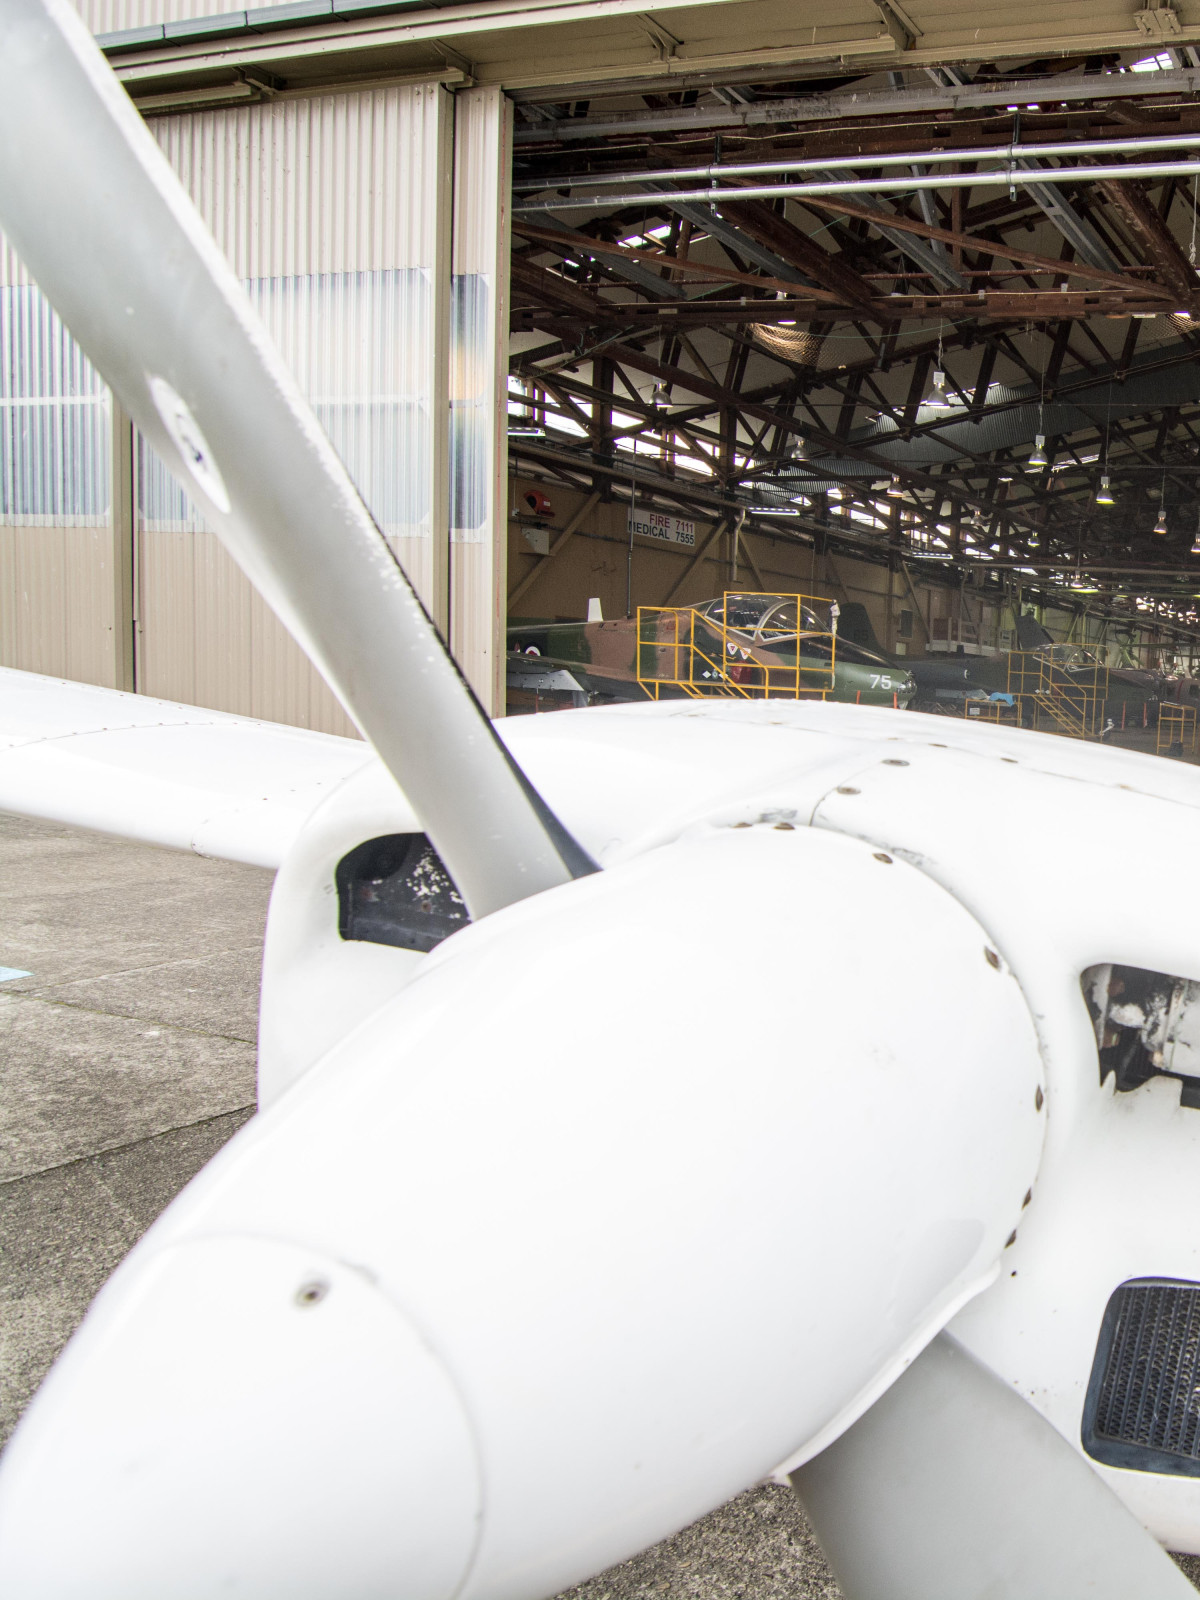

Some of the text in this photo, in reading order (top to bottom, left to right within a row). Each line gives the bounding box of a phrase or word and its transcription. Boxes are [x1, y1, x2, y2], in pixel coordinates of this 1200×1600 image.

[628, 520, 695, 545] MEDICAL 7555
[649, 513, 694, 533] FIRE 7111
[869, 674, 892, 690] 75
